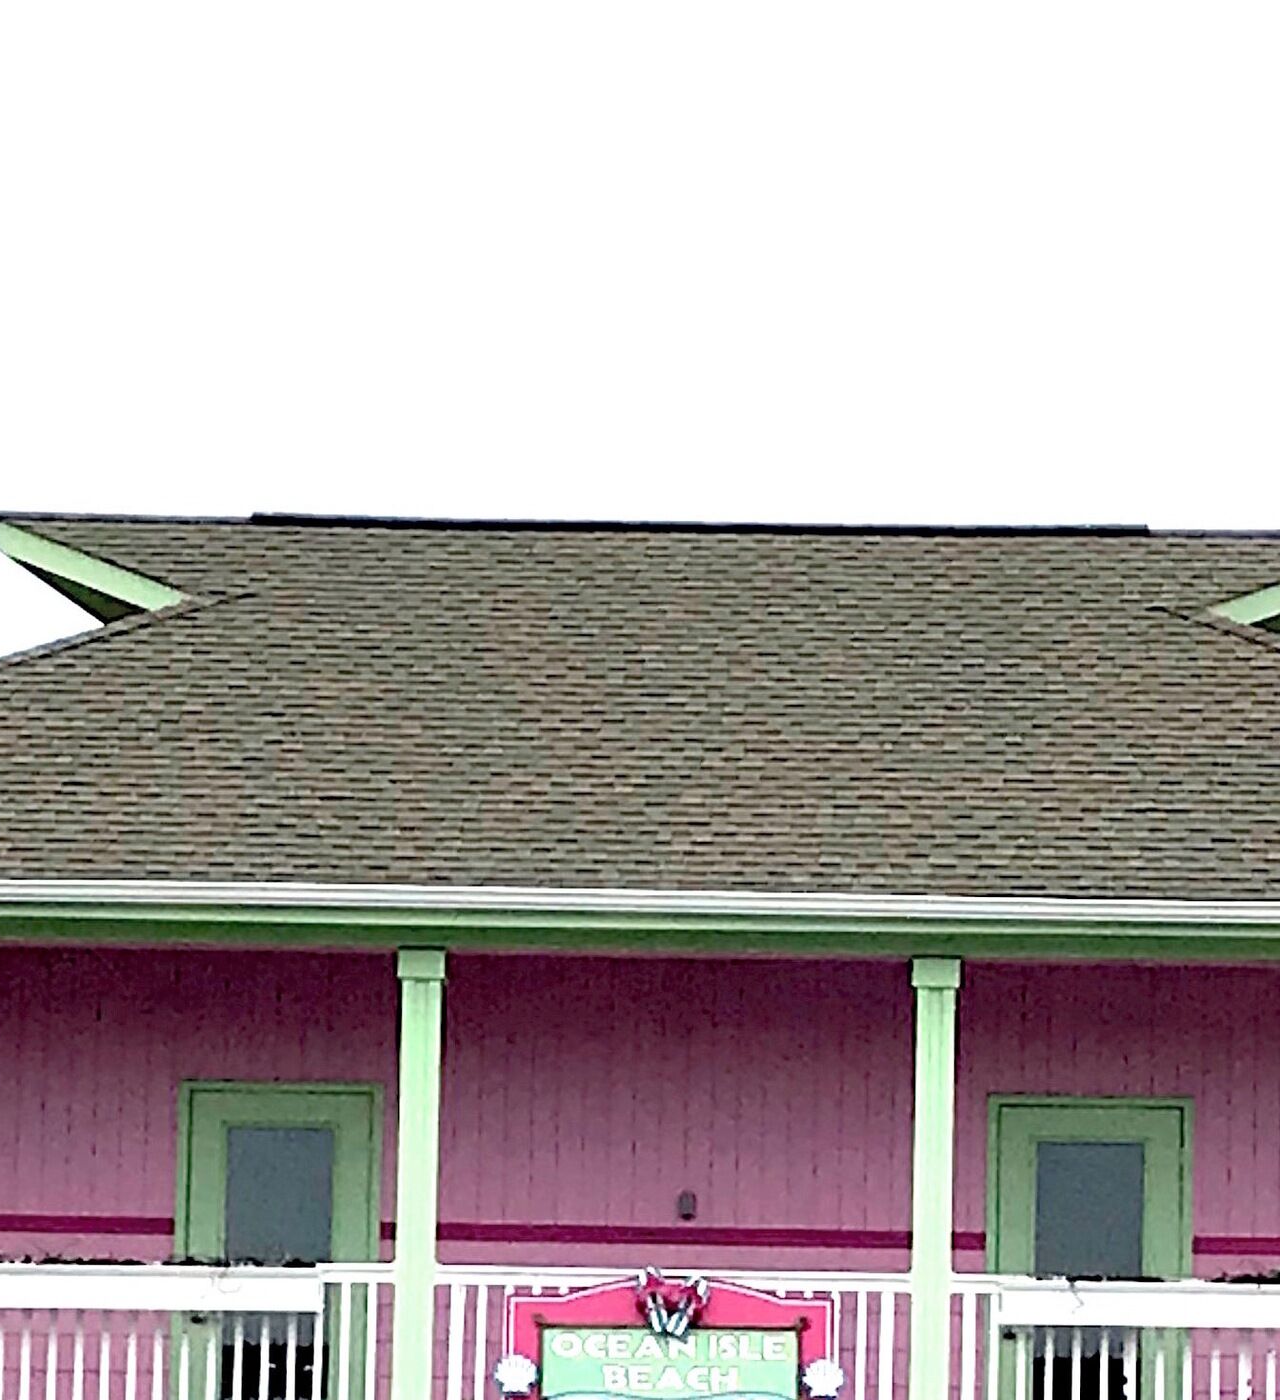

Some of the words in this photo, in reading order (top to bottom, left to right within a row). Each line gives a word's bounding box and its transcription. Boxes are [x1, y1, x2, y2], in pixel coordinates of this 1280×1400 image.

[550, 1332, 697, 1361] OCEAN
[708, 1333, 788, 1362] ISLE
[601, 1364, 739, 1394] BEACH
